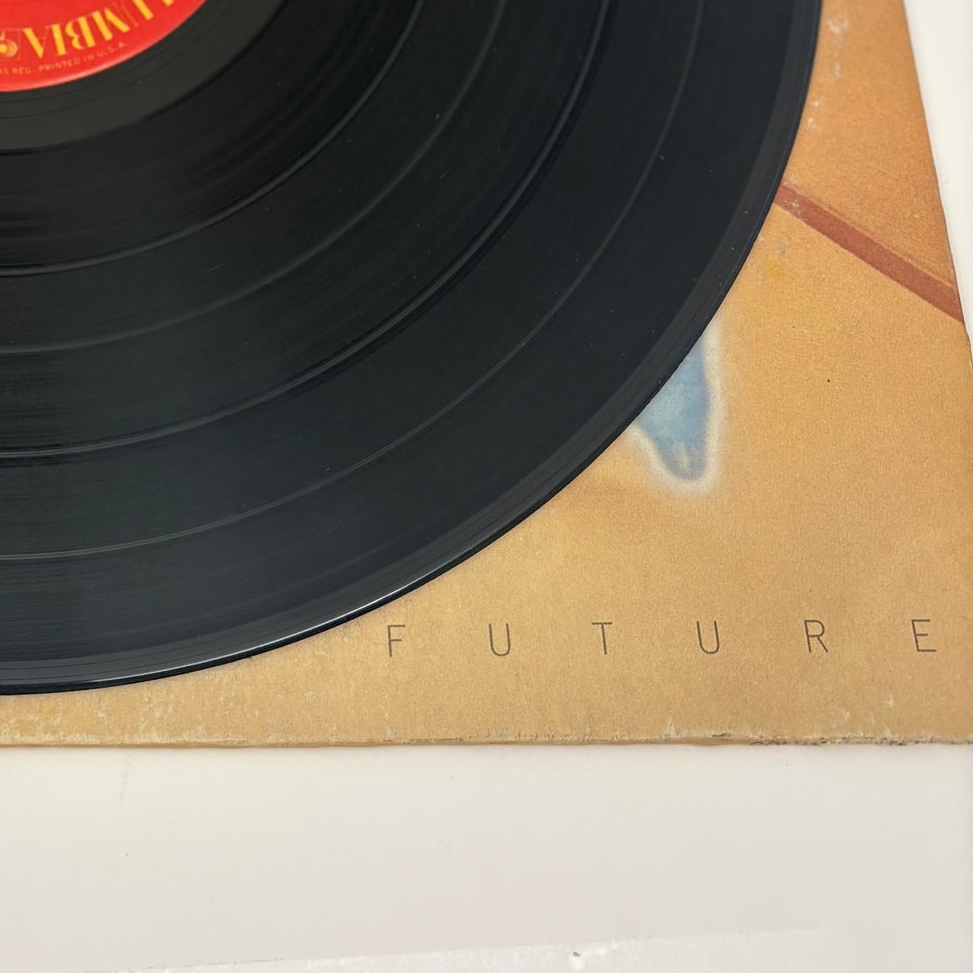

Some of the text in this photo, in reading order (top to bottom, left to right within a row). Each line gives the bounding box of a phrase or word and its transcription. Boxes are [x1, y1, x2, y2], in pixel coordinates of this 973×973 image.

[38, 57, 81, 74] PRINTED
[82, 53, 95, 63] IN
[386, 618, 939, 659] FUTURE
